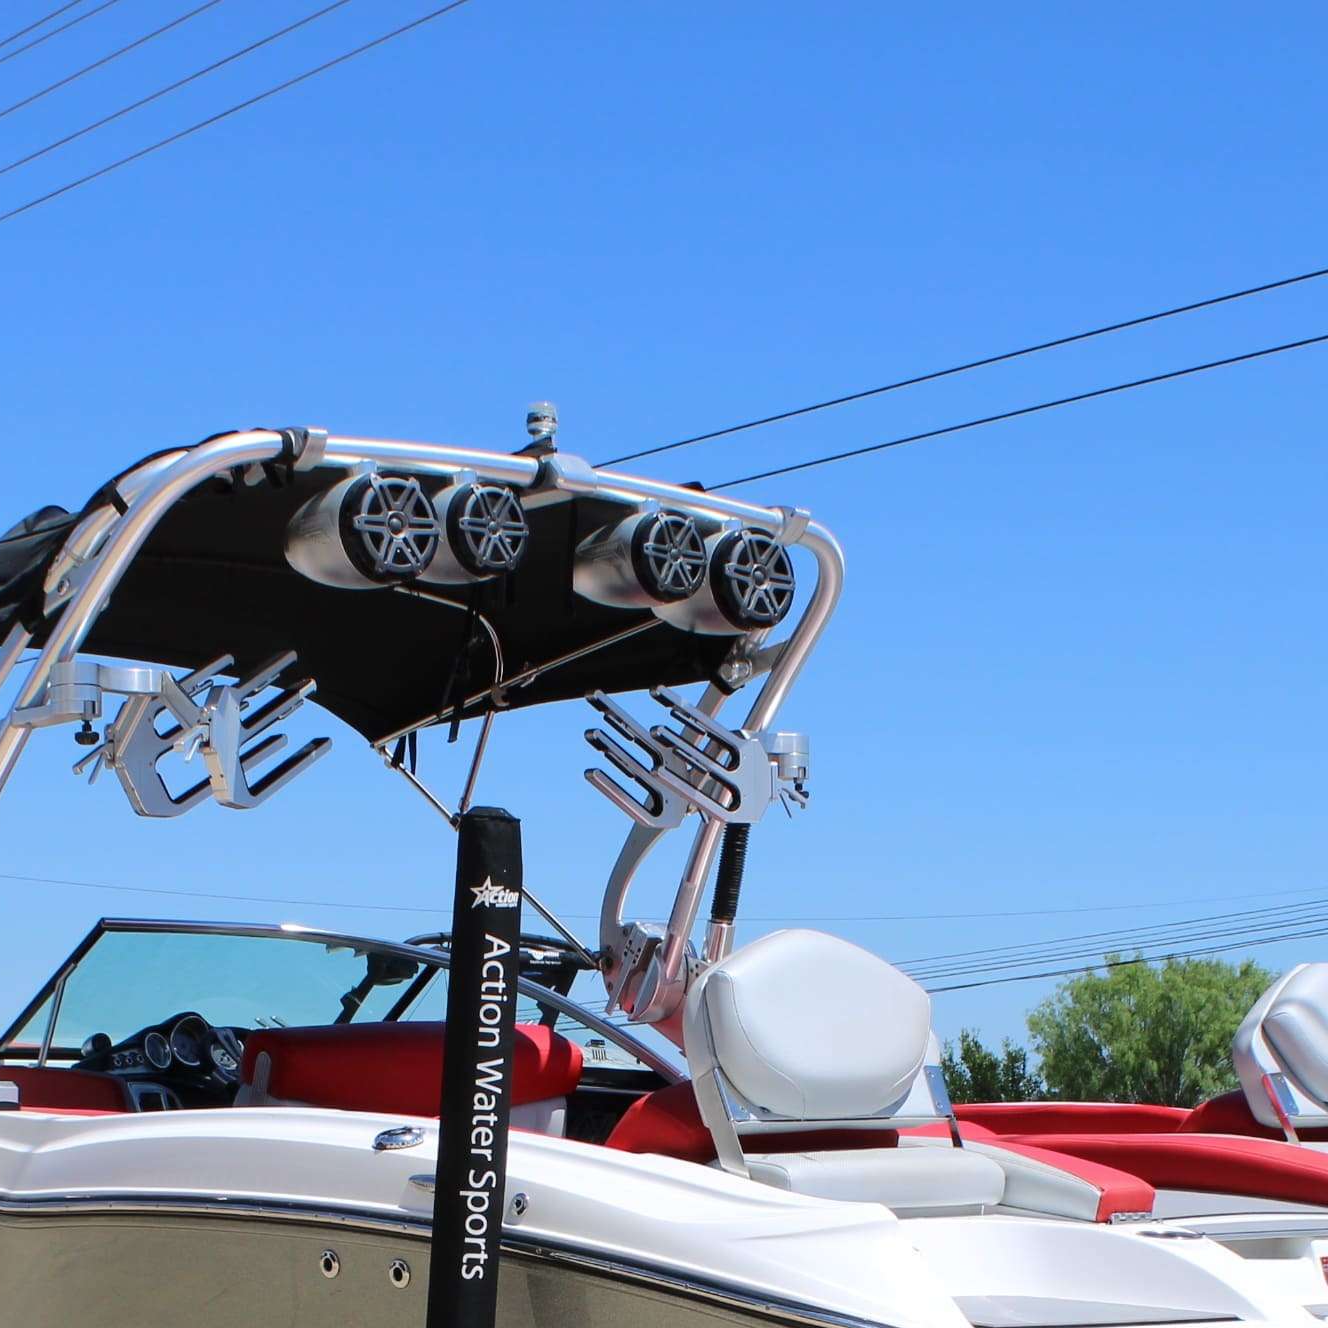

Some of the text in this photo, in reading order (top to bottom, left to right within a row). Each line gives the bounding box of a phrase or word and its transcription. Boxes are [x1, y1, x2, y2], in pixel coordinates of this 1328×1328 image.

[478, 933, 511, 1048] Action
[471, 1058, 504, 1162] Water
[459, 1169, 496, 1280] Sports
